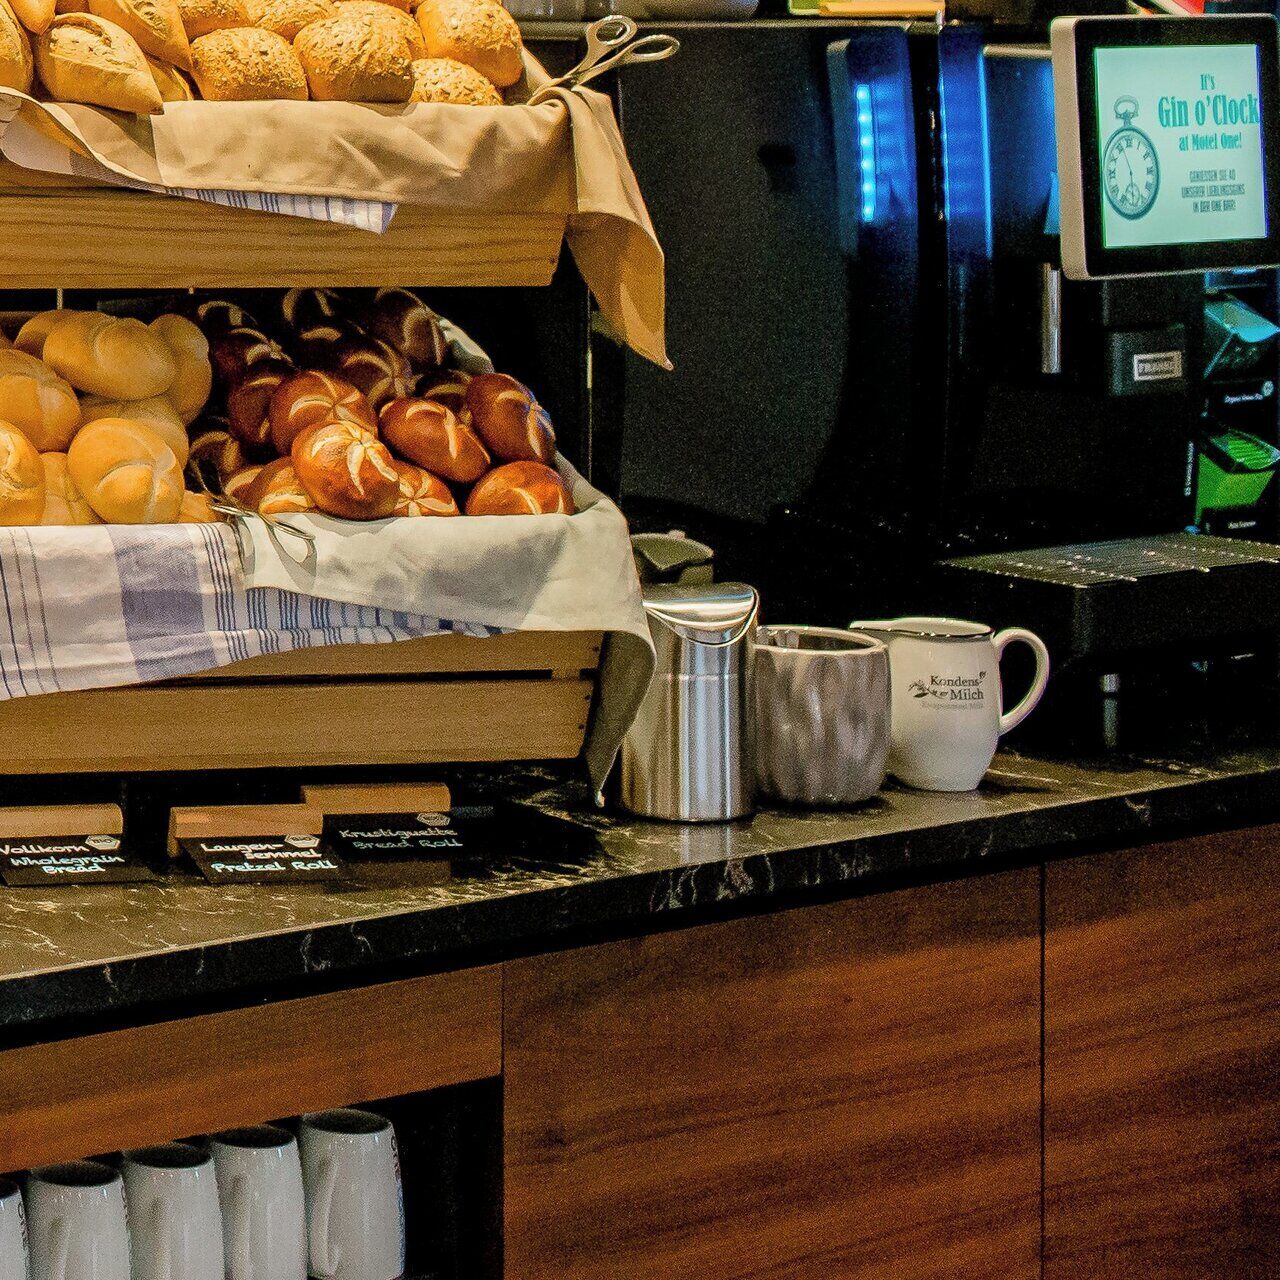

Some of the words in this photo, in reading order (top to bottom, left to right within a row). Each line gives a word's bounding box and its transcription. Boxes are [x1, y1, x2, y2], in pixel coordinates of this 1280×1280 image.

[1199, 72, 1216, 91] It's
[1157, 95, 1190, 128] Gin
[1193, 93, 1260, 126] o'Clock
[1191, 133, 1218, 150] Motel
[949, 687, 985, 701] Milch
[92, 837, 115, 847] BIO
[200, 842, 284, 853] Laugen-
[419, 837, 464, 848] Roll
[9, 854, 126, 868] Wholegrain
[210, 861, 287, 874] Pretzel
[291, 858, 339, 871] Roll
[41, 863, 107, 876] Bread
